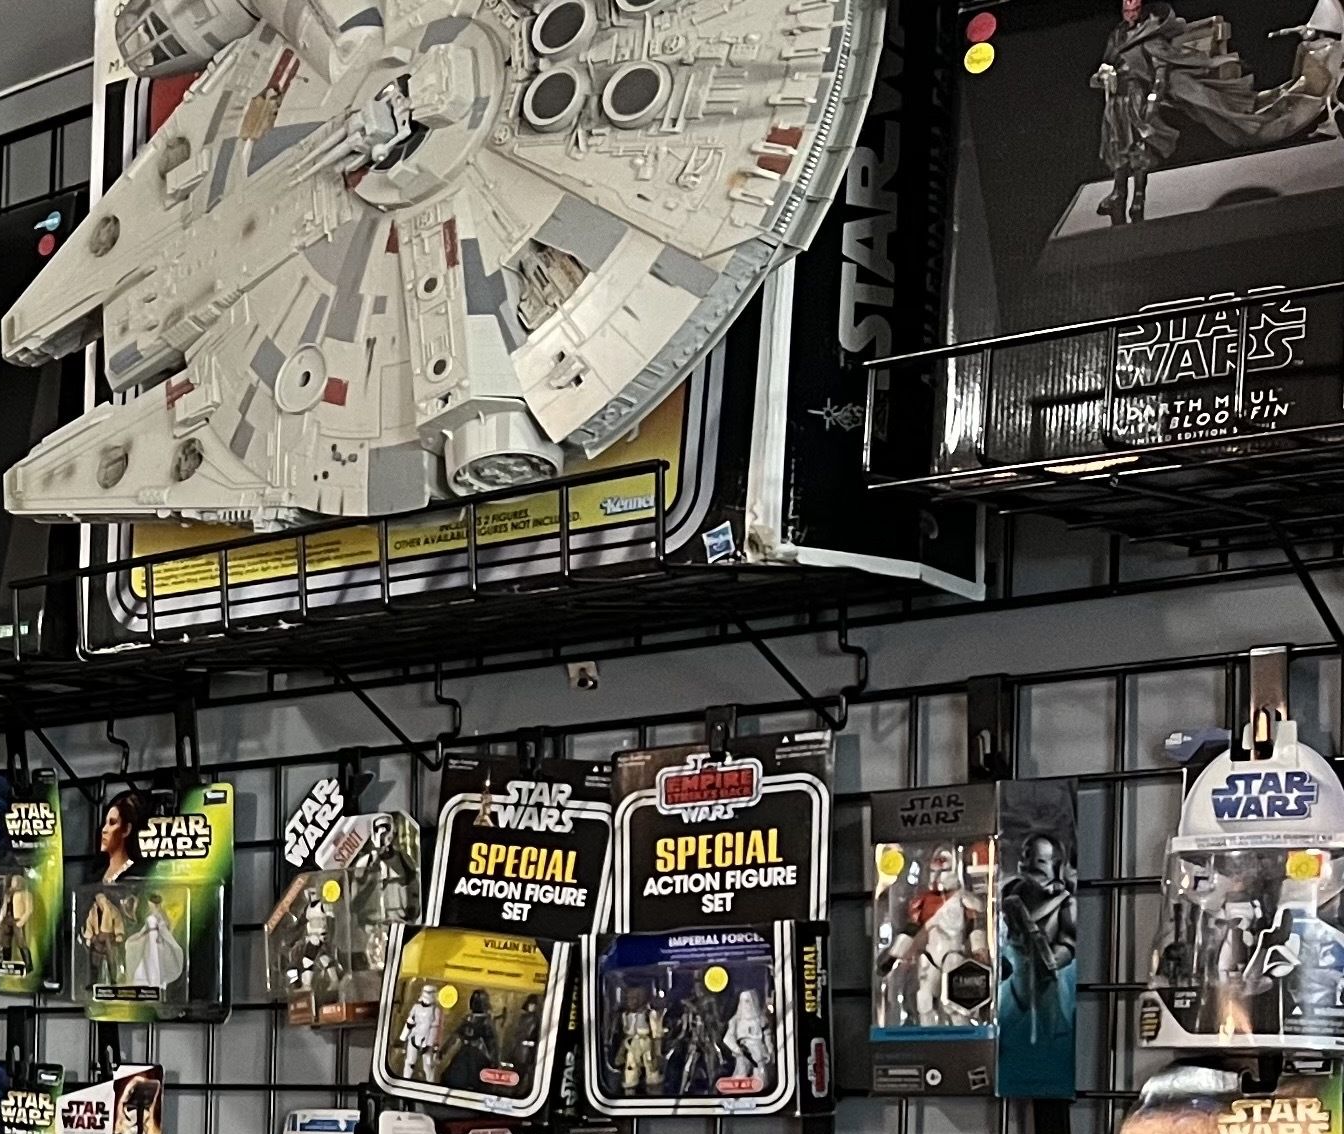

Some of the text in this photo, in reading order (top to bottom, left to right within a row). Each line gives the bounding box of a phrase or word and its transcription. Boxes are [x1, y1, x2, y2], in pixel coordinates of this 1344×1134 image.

[1115, 323, 1306, 390] WARS
[1214, 389, 1278, 409] MUL
[1169, 403, 1289, 430] BLOOFIN
[506, 780, 573, 807] STAR
[1212, 770, 1319, 798] STAR
[5, 803, 55, 820] STAR
[900, 794, 965, 812] STAR
[1212, 794, 1317, 820] WARS
[285, 778, 339, 852] STAR
[496, 806, 574, 834] WARS
[681, 808, 734, 826] WARS
[900, 809, 965, 829] WARS
[5, 818, 56, 836] WARS
[138, 816, 211, 838] STAR
[286, 786, 344, 867] WARS
[138, 835, 212, 858] WARS
[654, 830, 783, 875] SPECIAL
[469, 842, 579, 884] SPECIAL
[454, 877, 588, 909] ACTION FIGURE
[643, 867, 798, 898] ACTION FIGURE
[501, 902, 532, 923] SET
[701, 894, 735, 915] SET
[484, 939, 538, 954] VILLAIN SET
[667, 935, 719, 949] IMPERIAL
[0, 1090, 54, 1110] STAR
[62, 1101, 110, 1118] STAR
[1218, 1098, 1331, 1124] STAR
[0, 1106, 54, 1127] WARS
[62, 1114, 110, 1130] WARS
